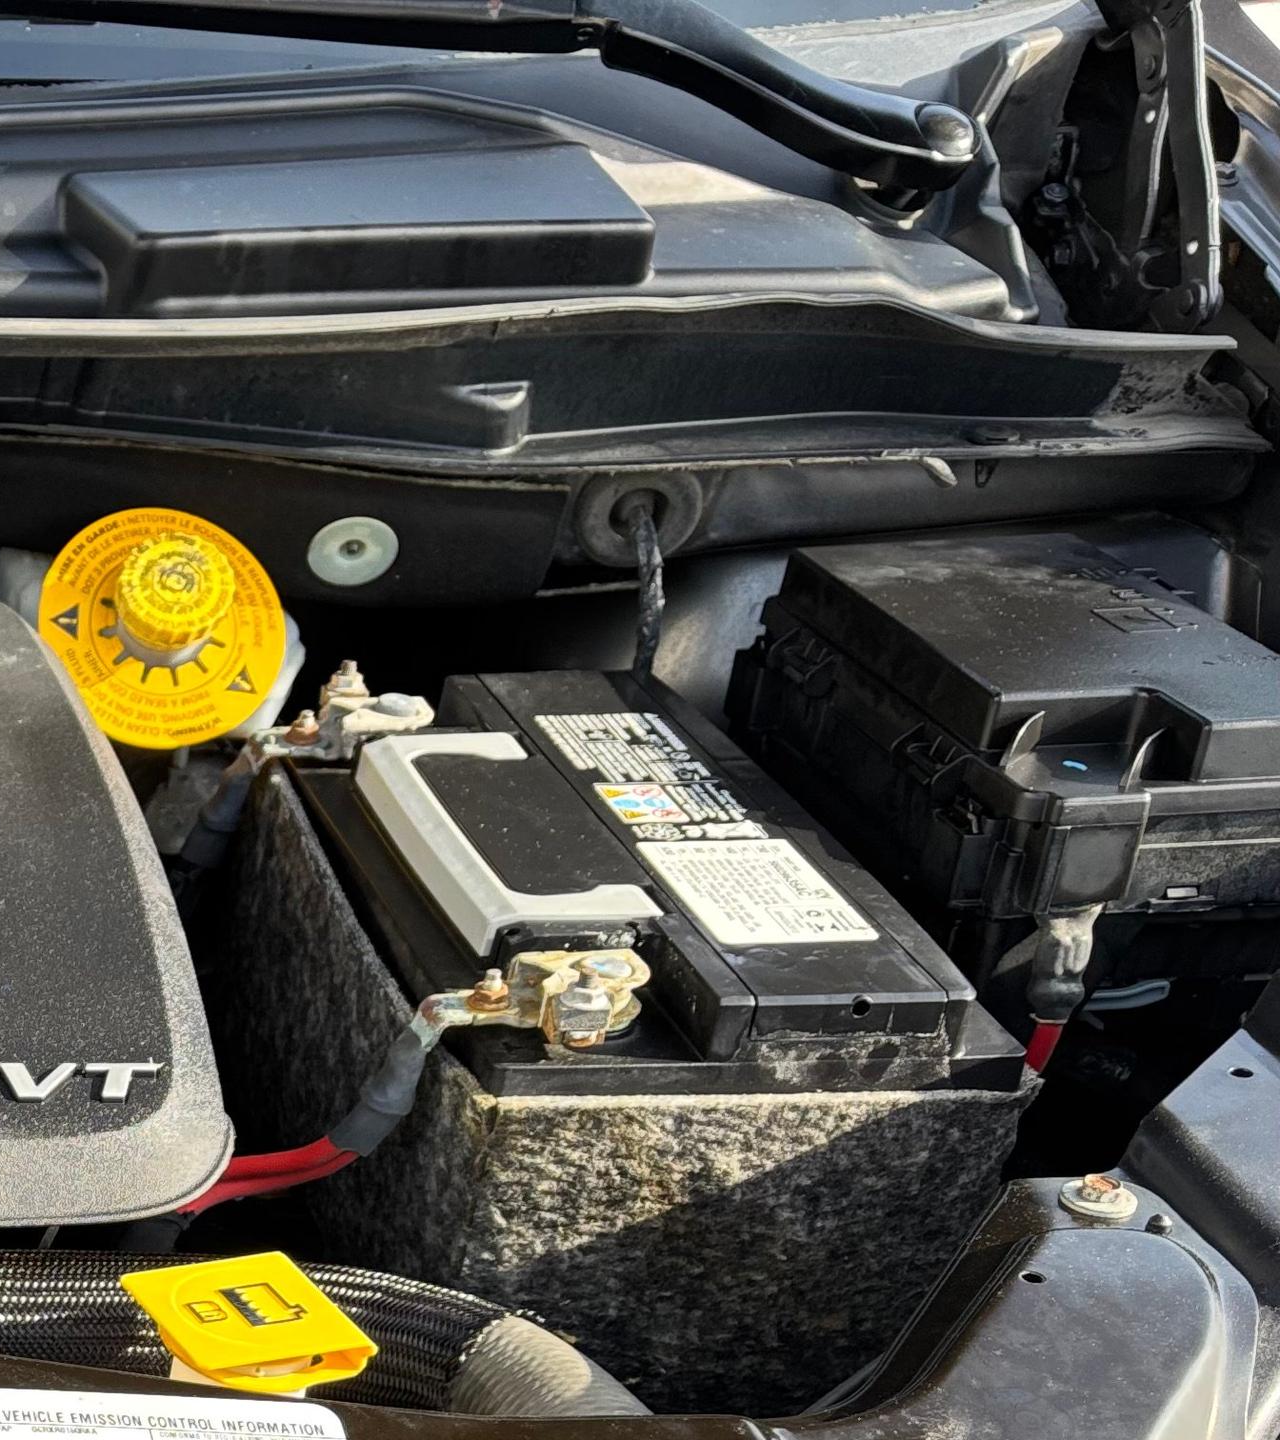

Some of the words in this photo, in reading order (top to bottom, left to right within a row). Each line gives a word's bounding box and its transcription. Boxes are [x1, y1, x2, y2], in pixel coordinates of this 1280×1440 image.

[2, 1409, 65, 1423] VEHICLE
[70, 1412, 142, 1427] EMISSION
[147, 1415, 217, 1431] CONTROL
[221, 1419, 325, 1436] INFORMATION
